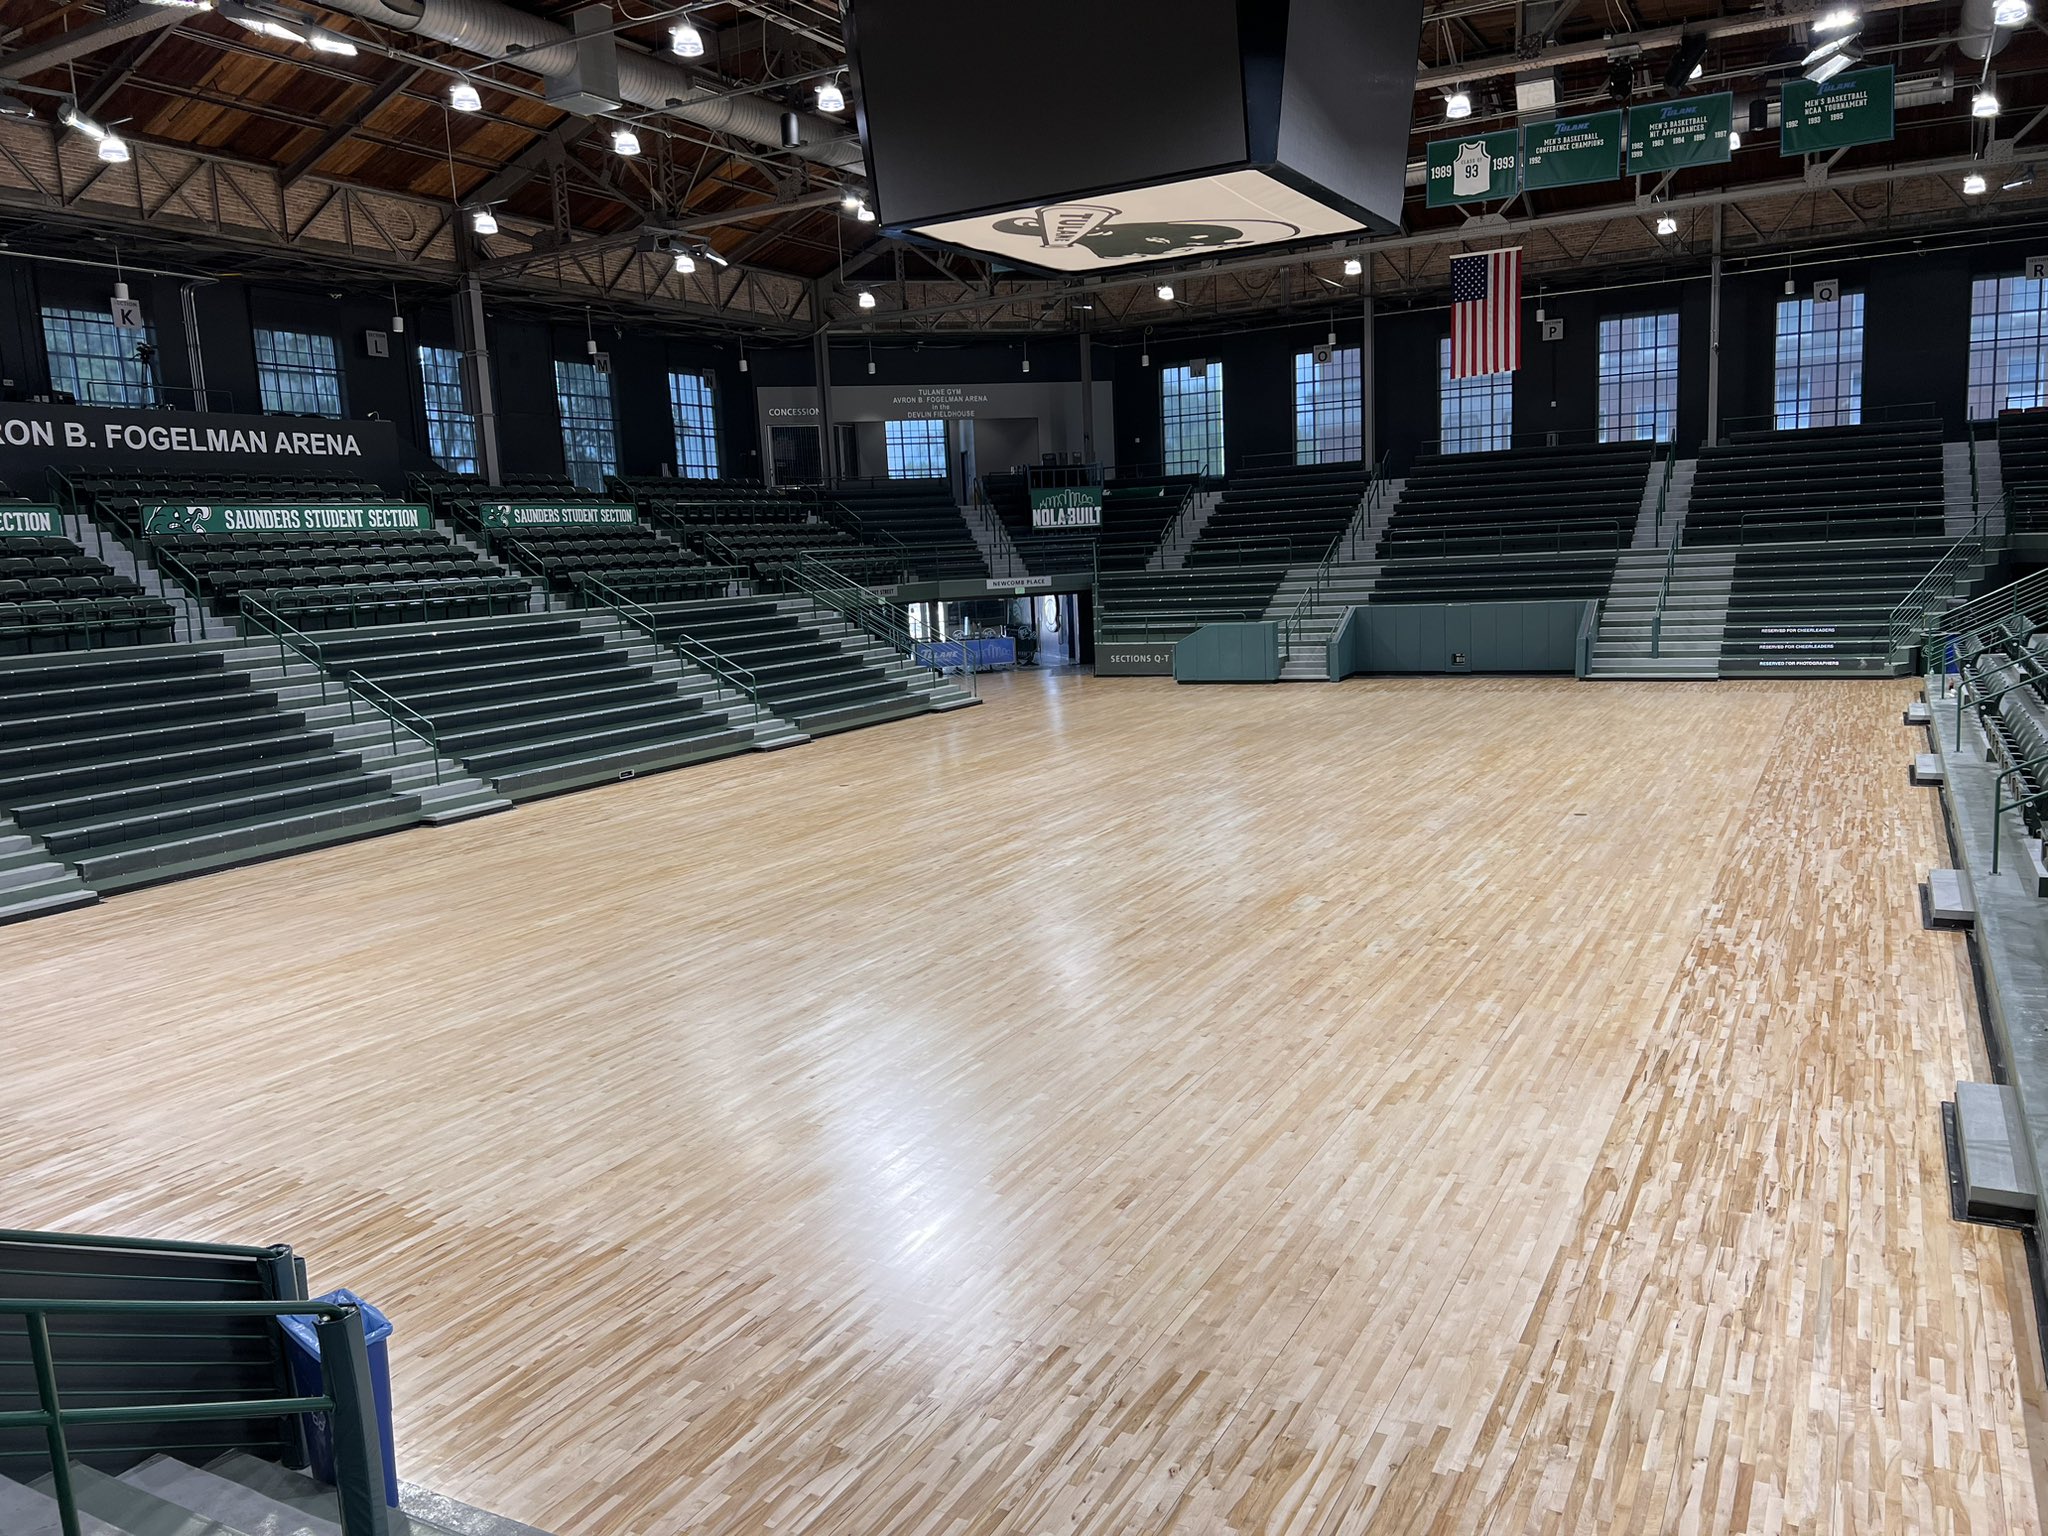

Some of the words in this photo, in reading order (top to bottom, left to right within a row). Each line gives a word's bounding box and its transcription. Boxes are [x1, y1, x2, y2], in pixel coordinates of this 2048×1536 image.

[1804, 98, 1825, 108] MEN'S
[1827, 91, 1868, 104] BASKETBALL
[1804, 106, 1822, 115] NCAA
[1824, 98, 1868, 111] TOURNAMENT
[1649, 122, 1668, 131] MEN'S
[1669, 115, 1708, 127] BASKETBALL
[1649, 130, 1659, 138] NIT
[1661, 124, 1705, 136] APPEARANCES
[1535, 143, 1570, 154] CONFERENCE
[1571, 139, 1604, 150] CHAMPIONS
[1543, 137, 1561, 146] MEN'S
[1563, 132, 1598, 143] BASKETBALL
[1431, 164, 1452, 180] 1989
[1465, 164, 1479, 179] 93
[1492, 155, 1515, 171] 1993
[1054, 213, 1094, 242] TULANE
[2033, 264, 2044, 277] R
[1819, 288, 1832, 302] Q
[120, 308, 135, 326] K
[1549, 326, 1557, 338] P
[374, 339, 383, 354] L
[1318, 351, 1328, 361] O
[596, 359, 609, 372] M
[918, 388, 945, 396] TULANE
[893, 396, 916, 404] AVRON
[933, 410, 975, 418] FIELDHOUSE
[0, 419, 54, 446] ON
[64, 422, 96, 448] B.
[104, 424, 268, 453] FOGELMAN
[274, 431, 362, 456] ARENA
[224, 509, 301, 529] SAUNDERS
[304, 509, 364, 528] STUDENT
[368, 509, 419, 528] SECTION
[514, 508, 560, 523] SAUNDERS
[561, 508, 598, 522] STUDENT
[600, 508, 632, 522] SECTION
[1032, 507, 1066, 526] NOLA
[1067, 506, 1102, 525] BUILT
[1110, 654, 1152, 663] SECTIONS
[1153, 654, 1170, 664] Q-T
